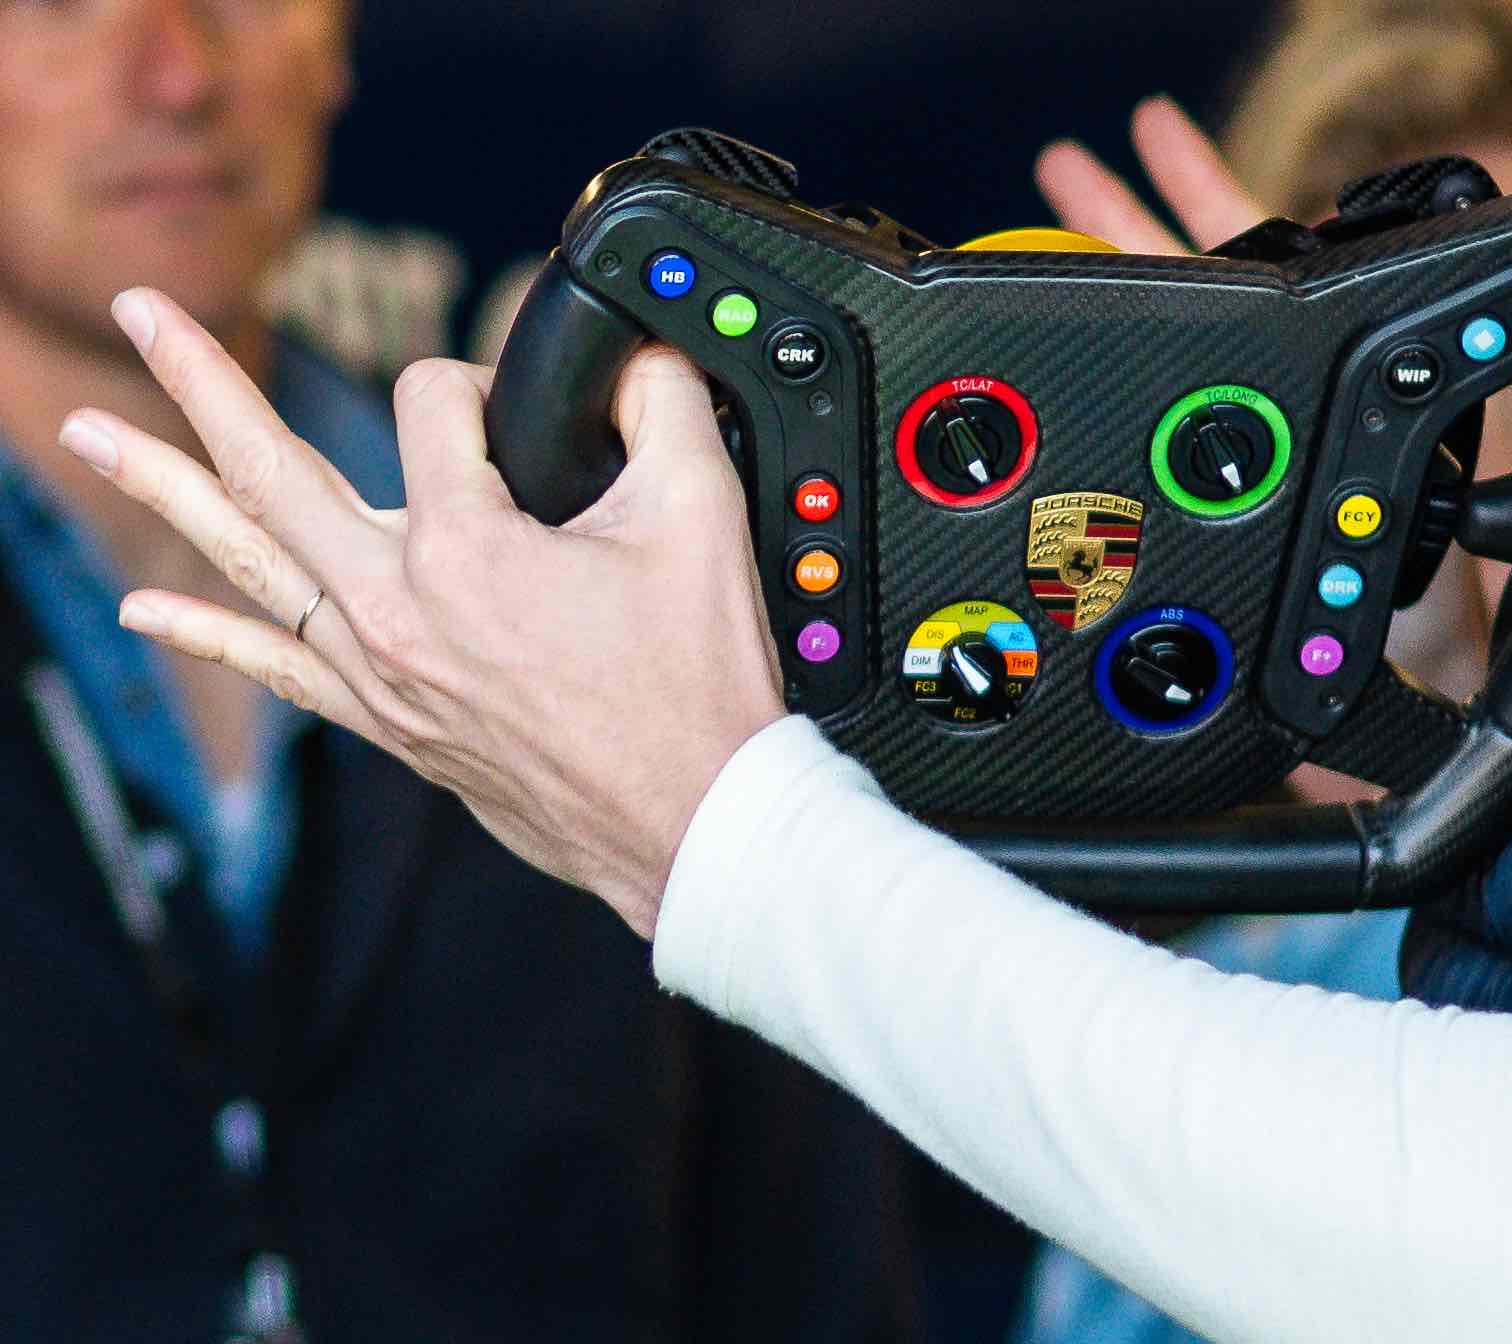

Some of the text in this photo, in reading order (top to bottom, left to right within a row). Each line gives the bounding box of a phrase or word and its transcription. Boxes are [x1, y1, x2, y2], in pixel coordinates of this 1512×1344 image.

[660, 270, 686, 284] HB
[777, 347, 815, 363] CRK
[1397, 368, 1431, 384] WIP
[951, 379, 994, 392] TC/LAT
[1206, 390, 1258, 404] TC/LONG
[804, 494, 829, 508] OK
[1033, 493, 1144, 514] PORSCHE
[1343, 510, 1377, 523] FCY
[1159, 608, 1185, 622] ABS
[911, 655, 931, 667] DIM
